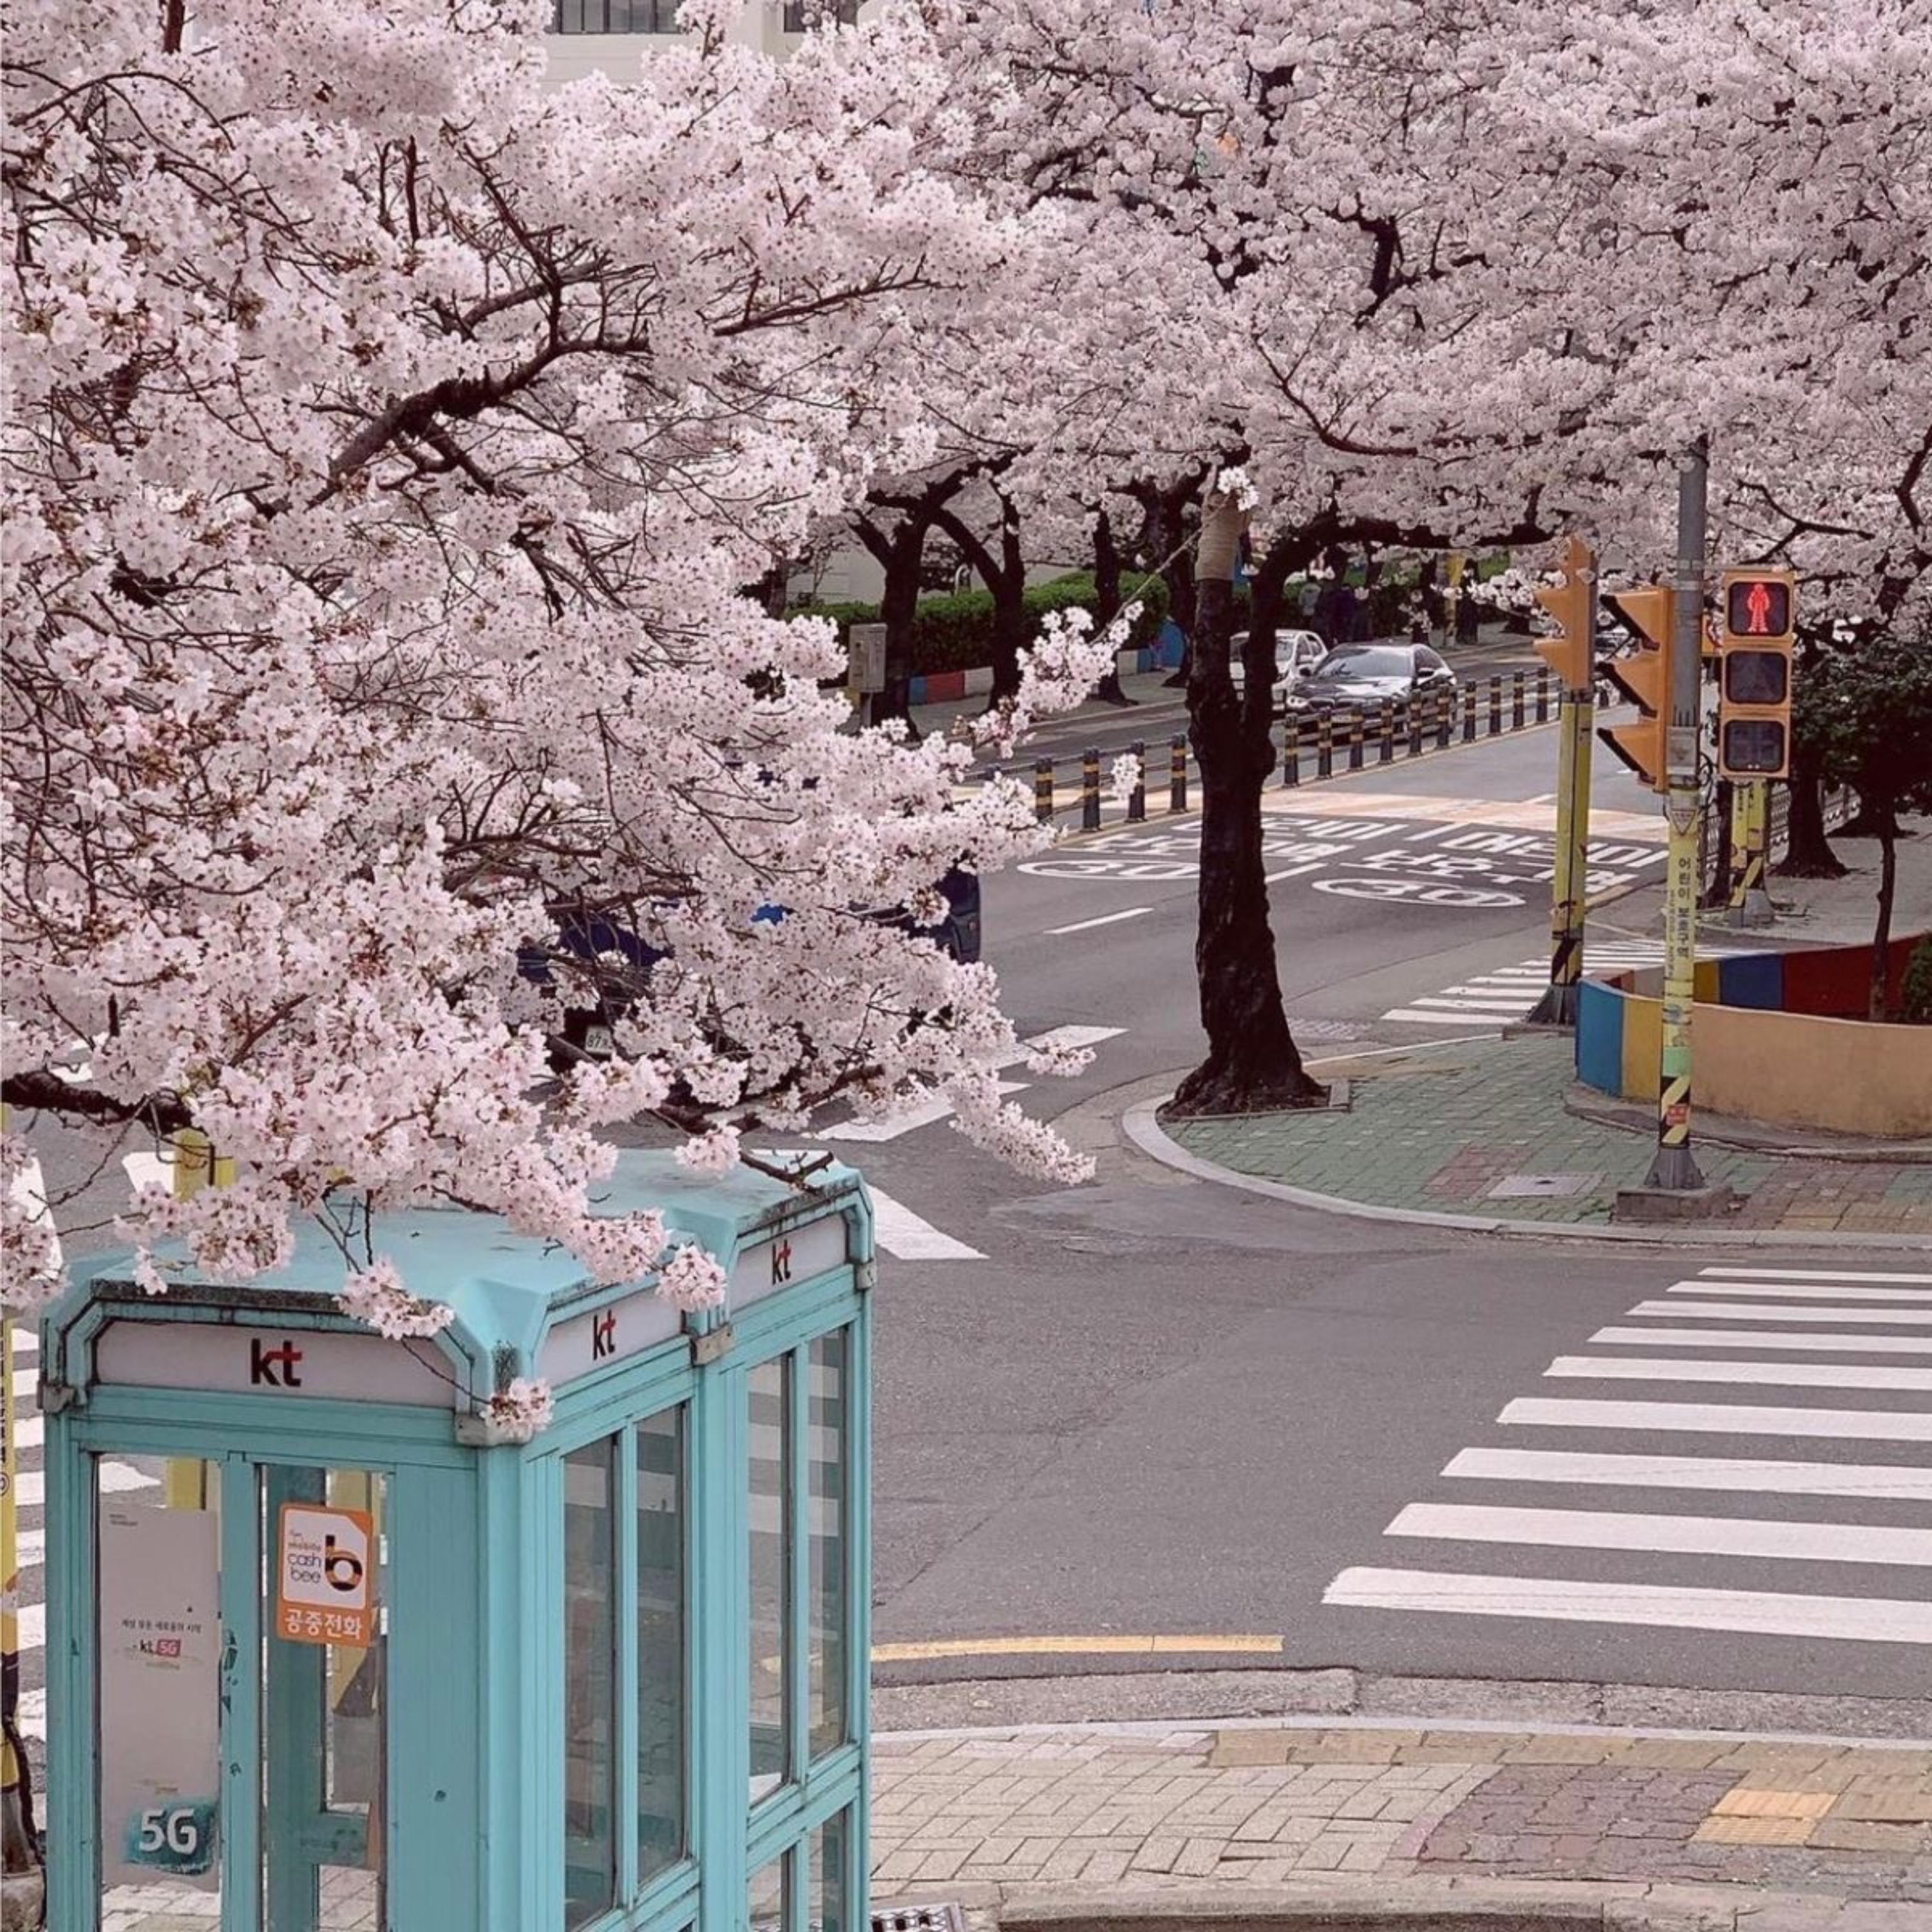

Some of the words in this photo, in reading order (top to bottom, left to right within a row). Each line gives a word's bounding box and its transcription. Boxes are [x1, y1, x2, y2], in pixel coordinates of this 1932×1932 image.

[772, 1239, 791, 1285] kt
[593, 1309, 616, 1360] kt
[251, 1338, 302, 1387] kt
[288, 1552, 321, 1567] cash
[290, 1567, 321, 1584] bee
[285, 1607, 362, 1640] 공중전화
[140, 1640, 155, 1654] kt
[160, 1642, 178, 1656] 5G
[138, 1808, 198, 1855] 5G
